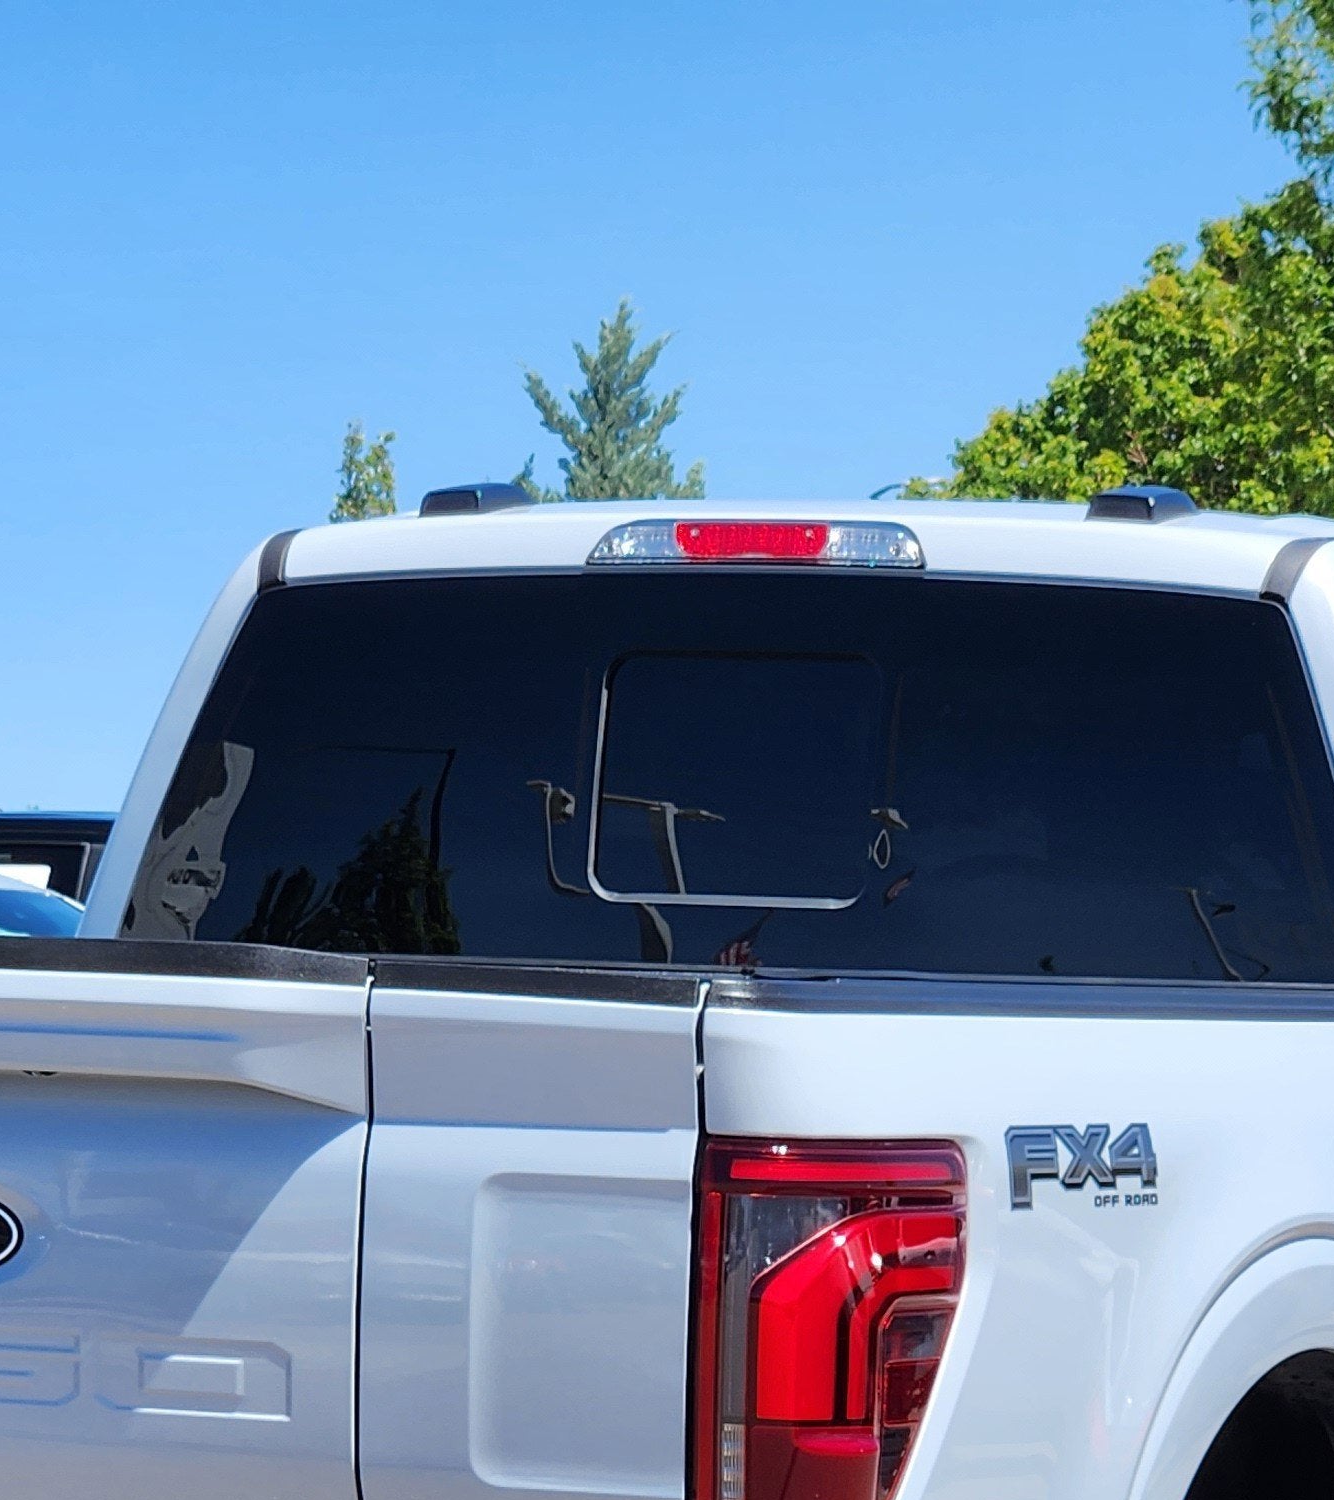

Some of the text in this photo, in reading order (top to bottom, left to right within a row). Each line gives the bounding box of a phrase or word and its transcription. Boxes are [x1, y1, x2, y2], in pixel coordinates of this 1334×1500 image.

[1004, 1123, 1159, 1211] FX4
[1094, 1193, 1159, 1208] OFF ROAD
